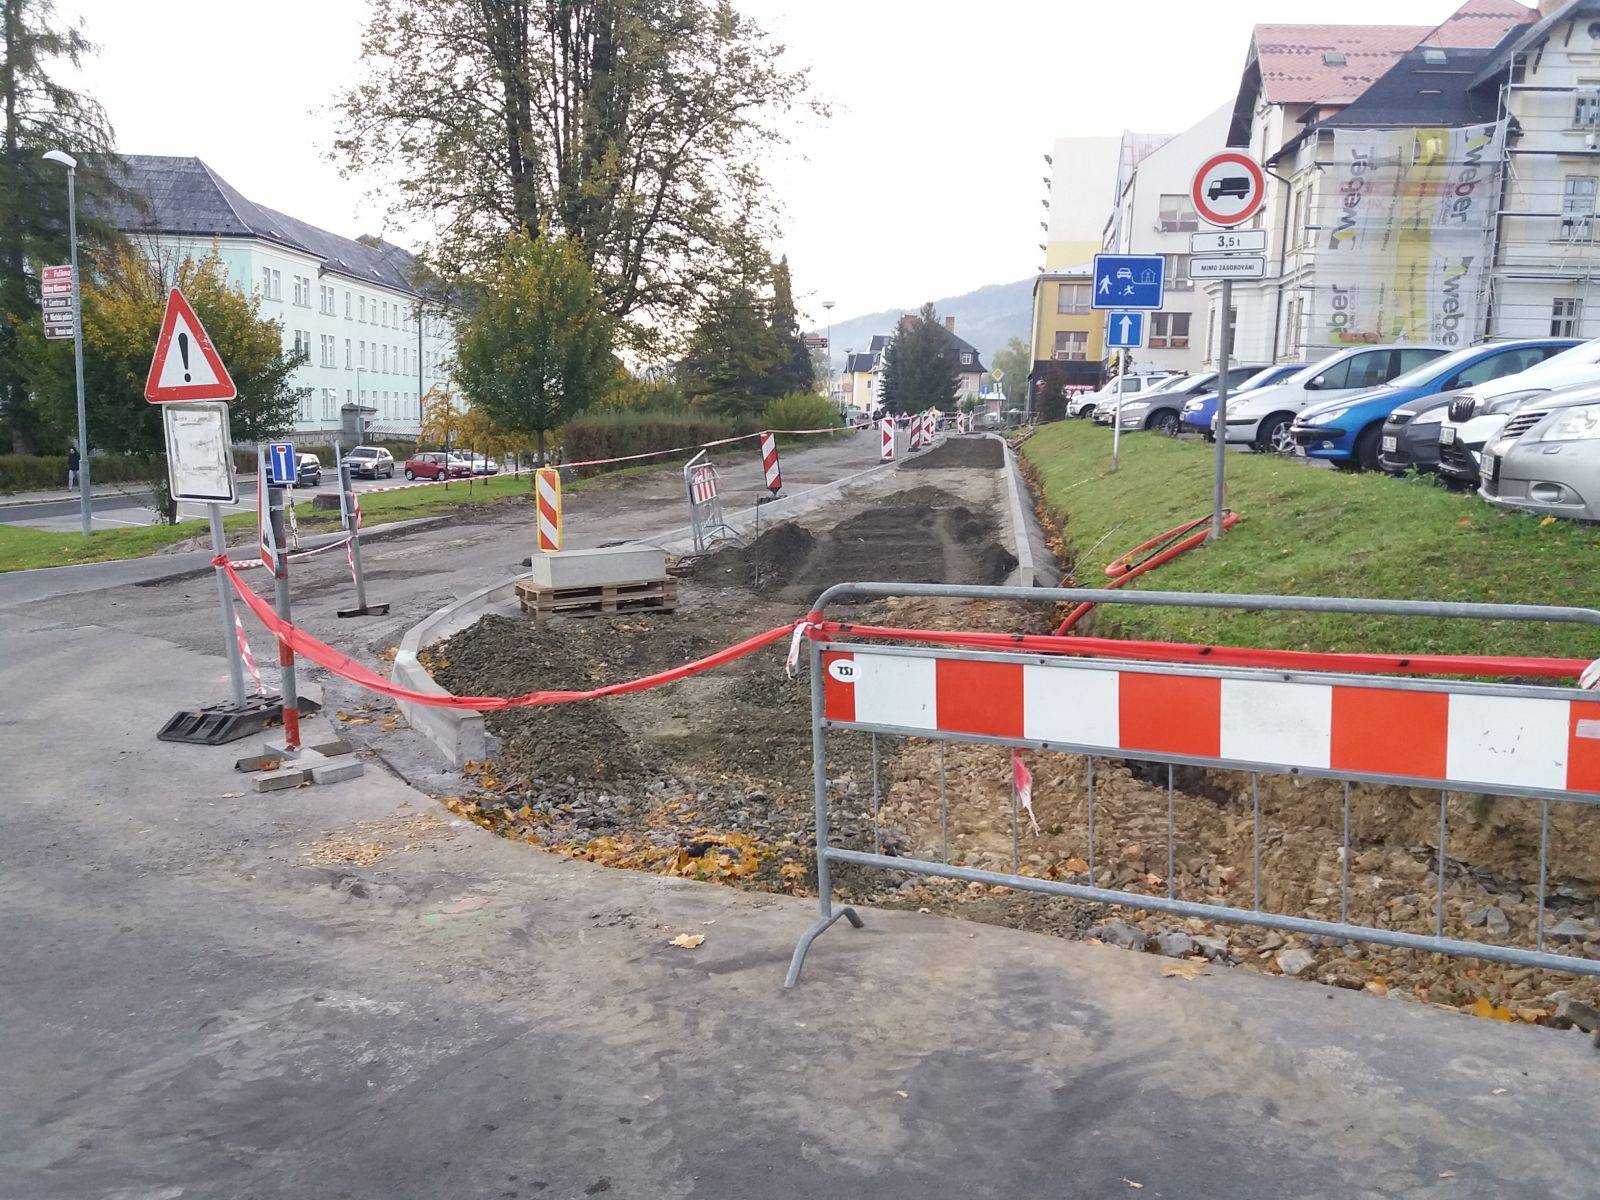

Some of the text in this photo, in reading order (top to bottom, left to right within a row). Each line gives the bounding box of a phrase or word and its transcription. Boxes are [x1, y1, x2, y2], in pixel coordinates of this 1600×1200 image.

[1338, 149, 1368, 231] weber
[1451, 145, 1481, 222] weber
[1217, 235, 1235, 248] 3,5
[837, 666, 853, 676] TSJ
